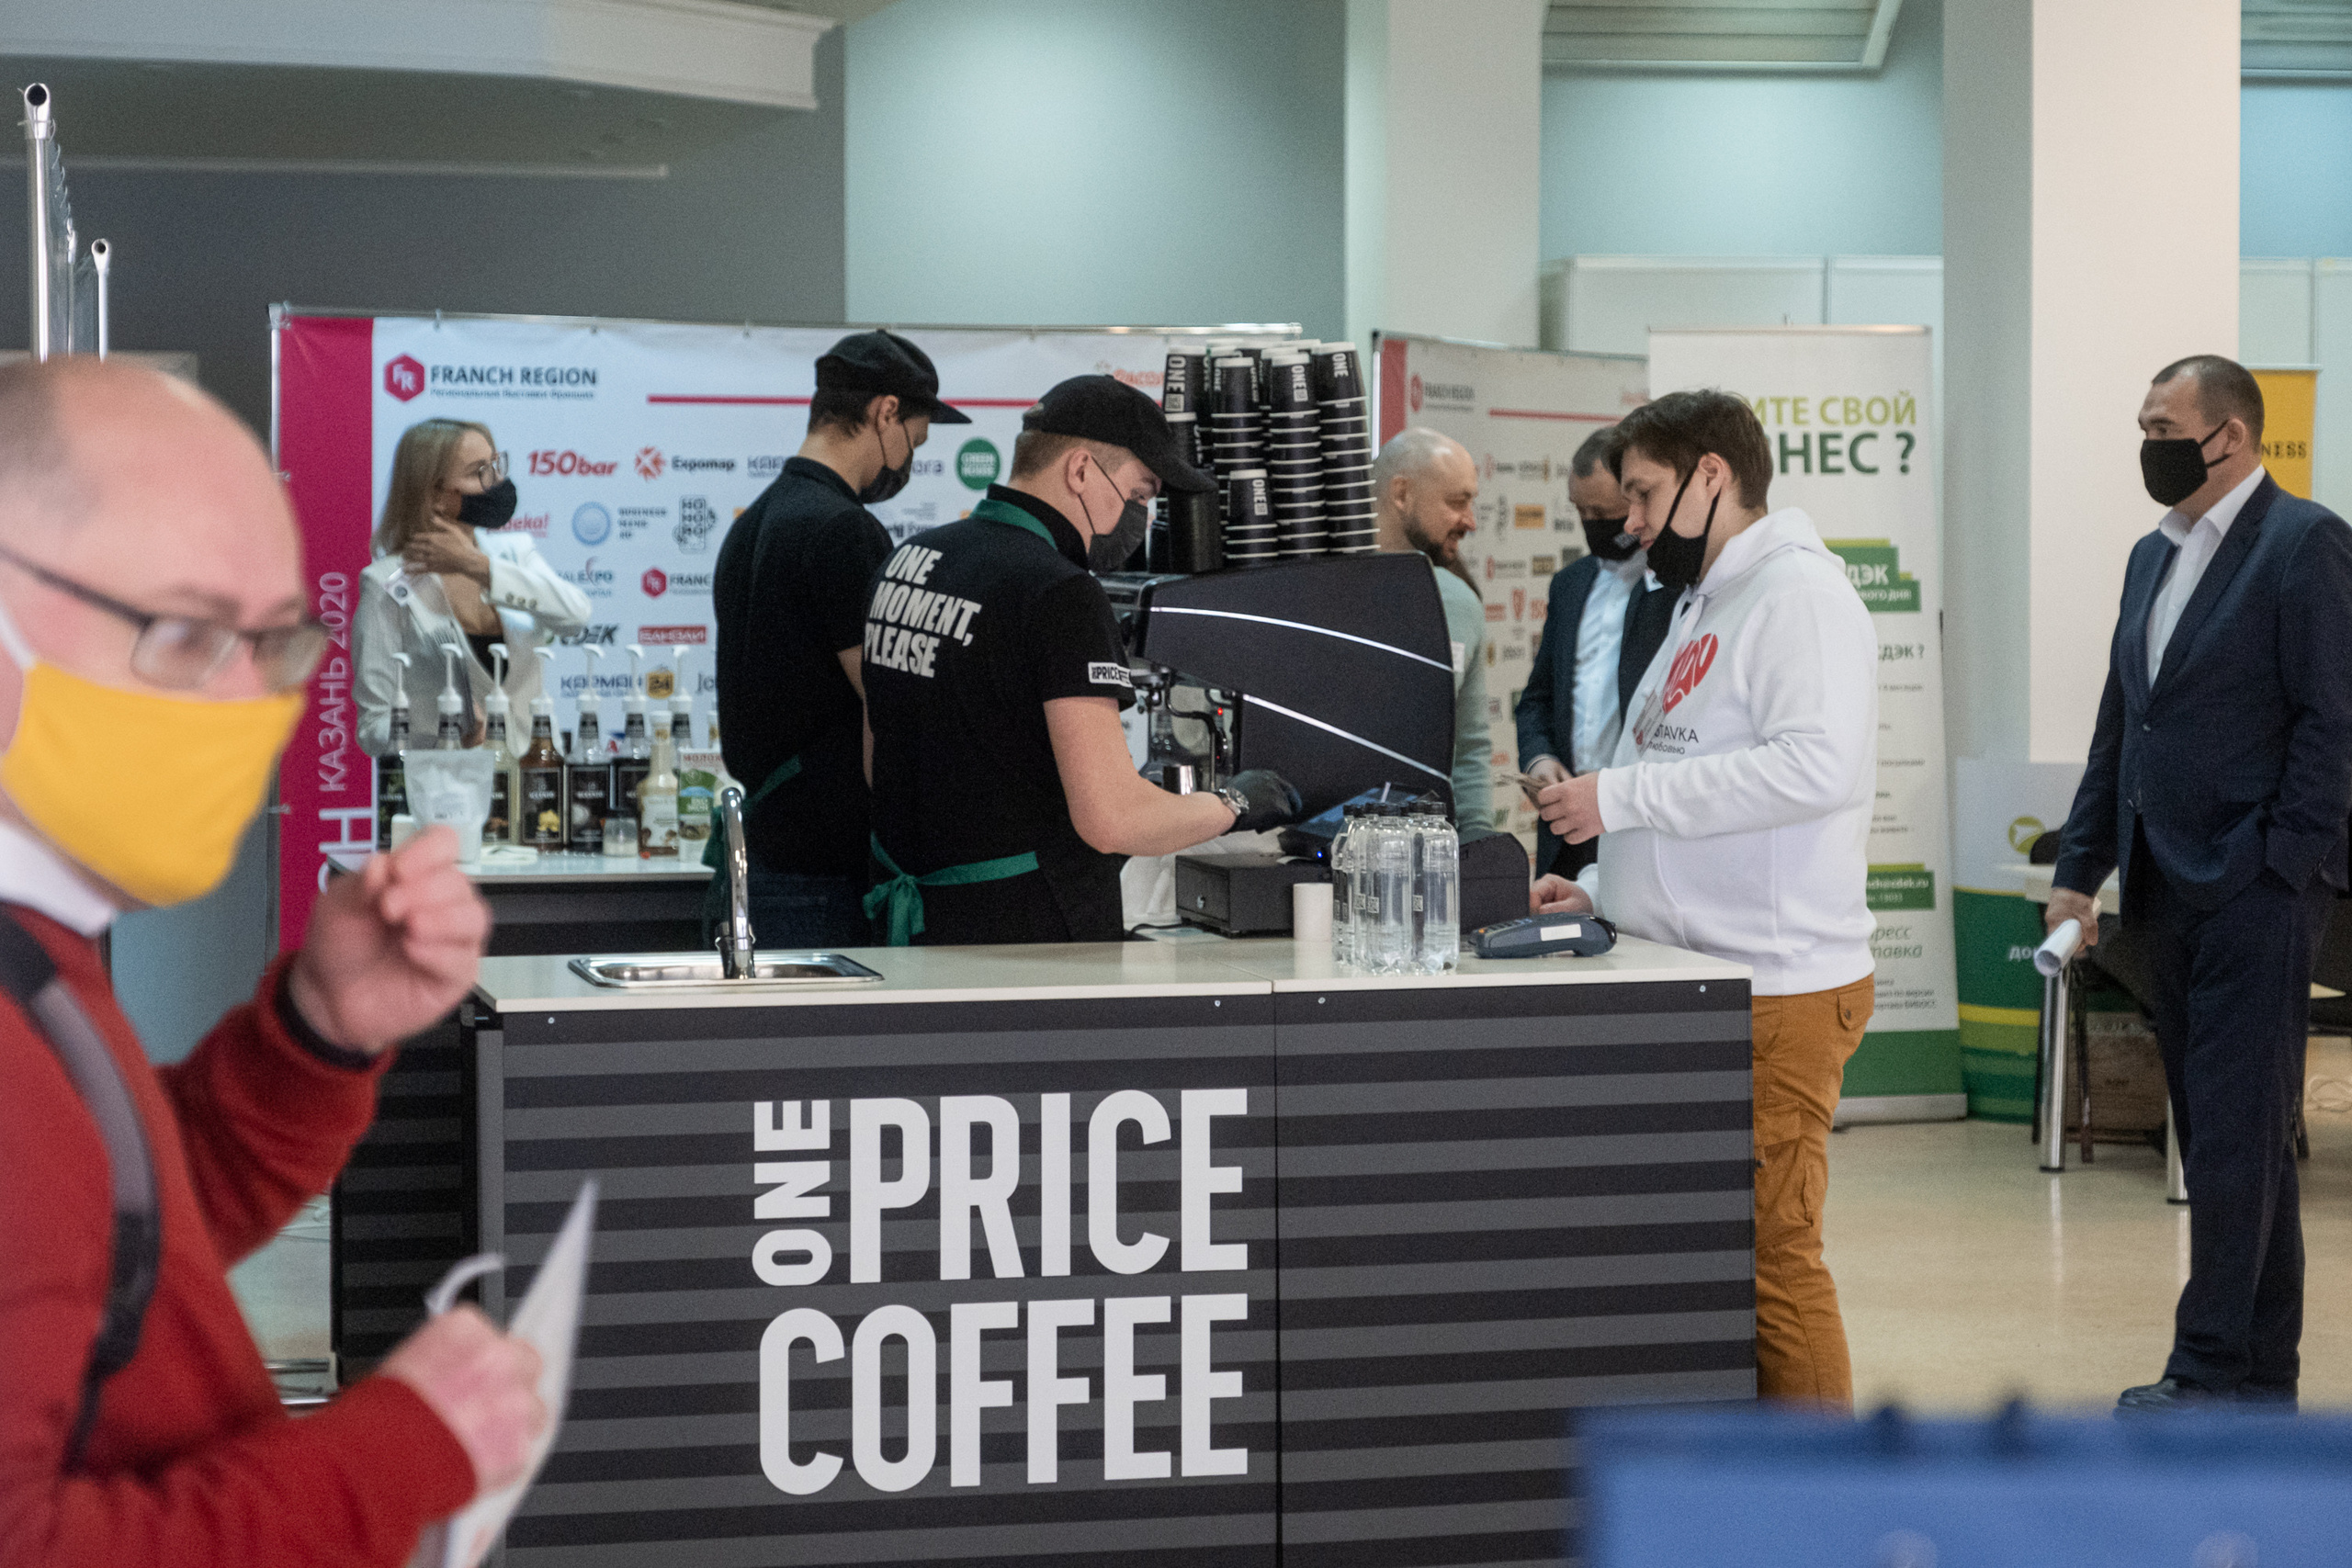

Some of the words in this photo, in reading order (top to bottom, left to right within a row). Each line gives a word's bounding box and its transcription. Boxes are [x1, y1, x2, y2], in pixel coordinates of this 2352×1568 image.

[431, 366, 513, 384] FRANCH
[520, 367, 596, 384] REGION
[1167, 355, 1186, 393] ONE
[1292, 365, 1306, 389] ONE
[1333, 353, 1349, 378] ONE
[1819, 389, 1917, 425] СВОЙ
[527, 450, 617, 476] 150bar
[672, 457, 735, 471] Expomap
[1767, 432, 1879, 474] НЕС
[1895, 432, 1917, 474] ?
[1252, 479, 1267, 503] ONE
[885, 544, 943, 586] ONE
[320, 571, 346, 649] 2020
[869, 581, 982, 647] MOMENT,
[864, 622, 940, 678] PLEASE
[319, 657, 345, 791] КАЗАНЬ
[752, 1100, 832, 1286] ONE
[850, 1089, 1248, 1283] PRICE
[759, 1293, 1248, 1495] COFFEE
